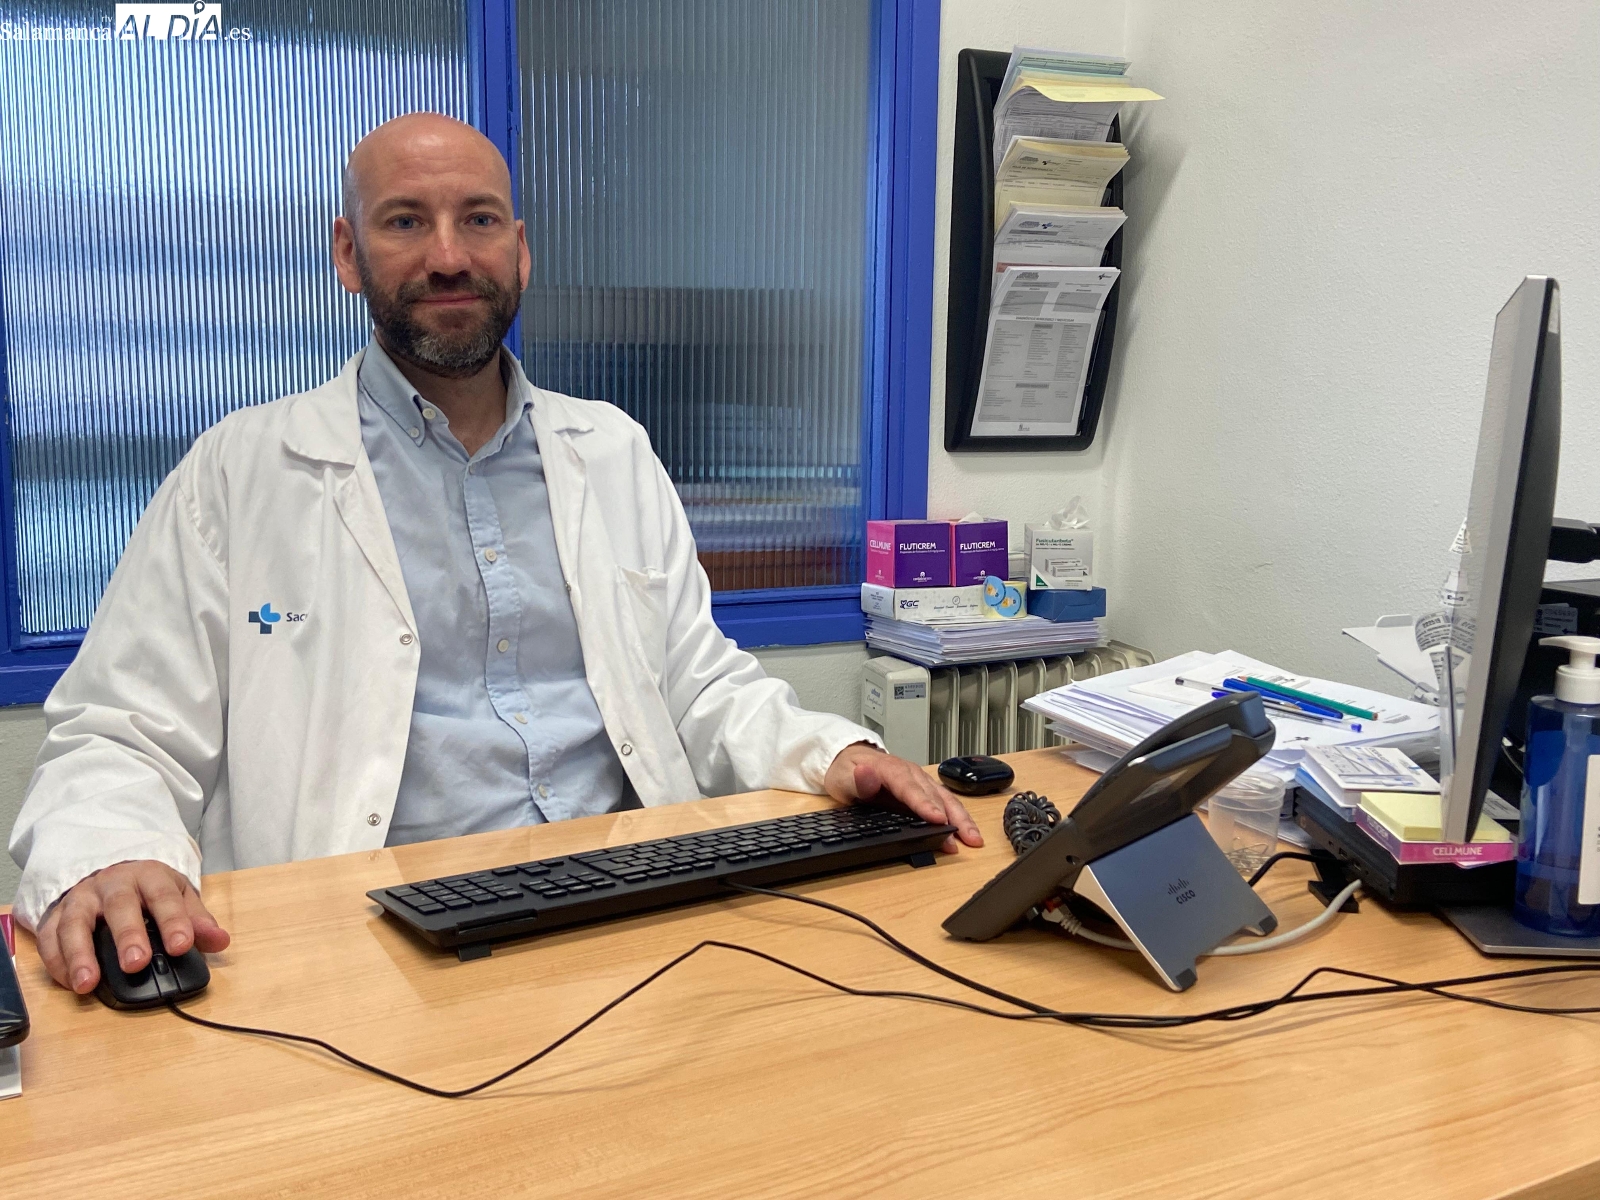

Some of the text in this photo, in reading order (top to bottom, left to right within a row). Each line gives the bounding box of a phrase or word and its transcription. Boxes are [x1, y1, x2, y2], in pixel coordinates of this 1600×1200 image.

[869, 539, 892, 551] CELLMUNE
[899, 542, 937, 551] FLUTICREM
[959, 541, 996, 551] FLUTICREM
[1432, 846, 1484, 856] CELLMUNE
